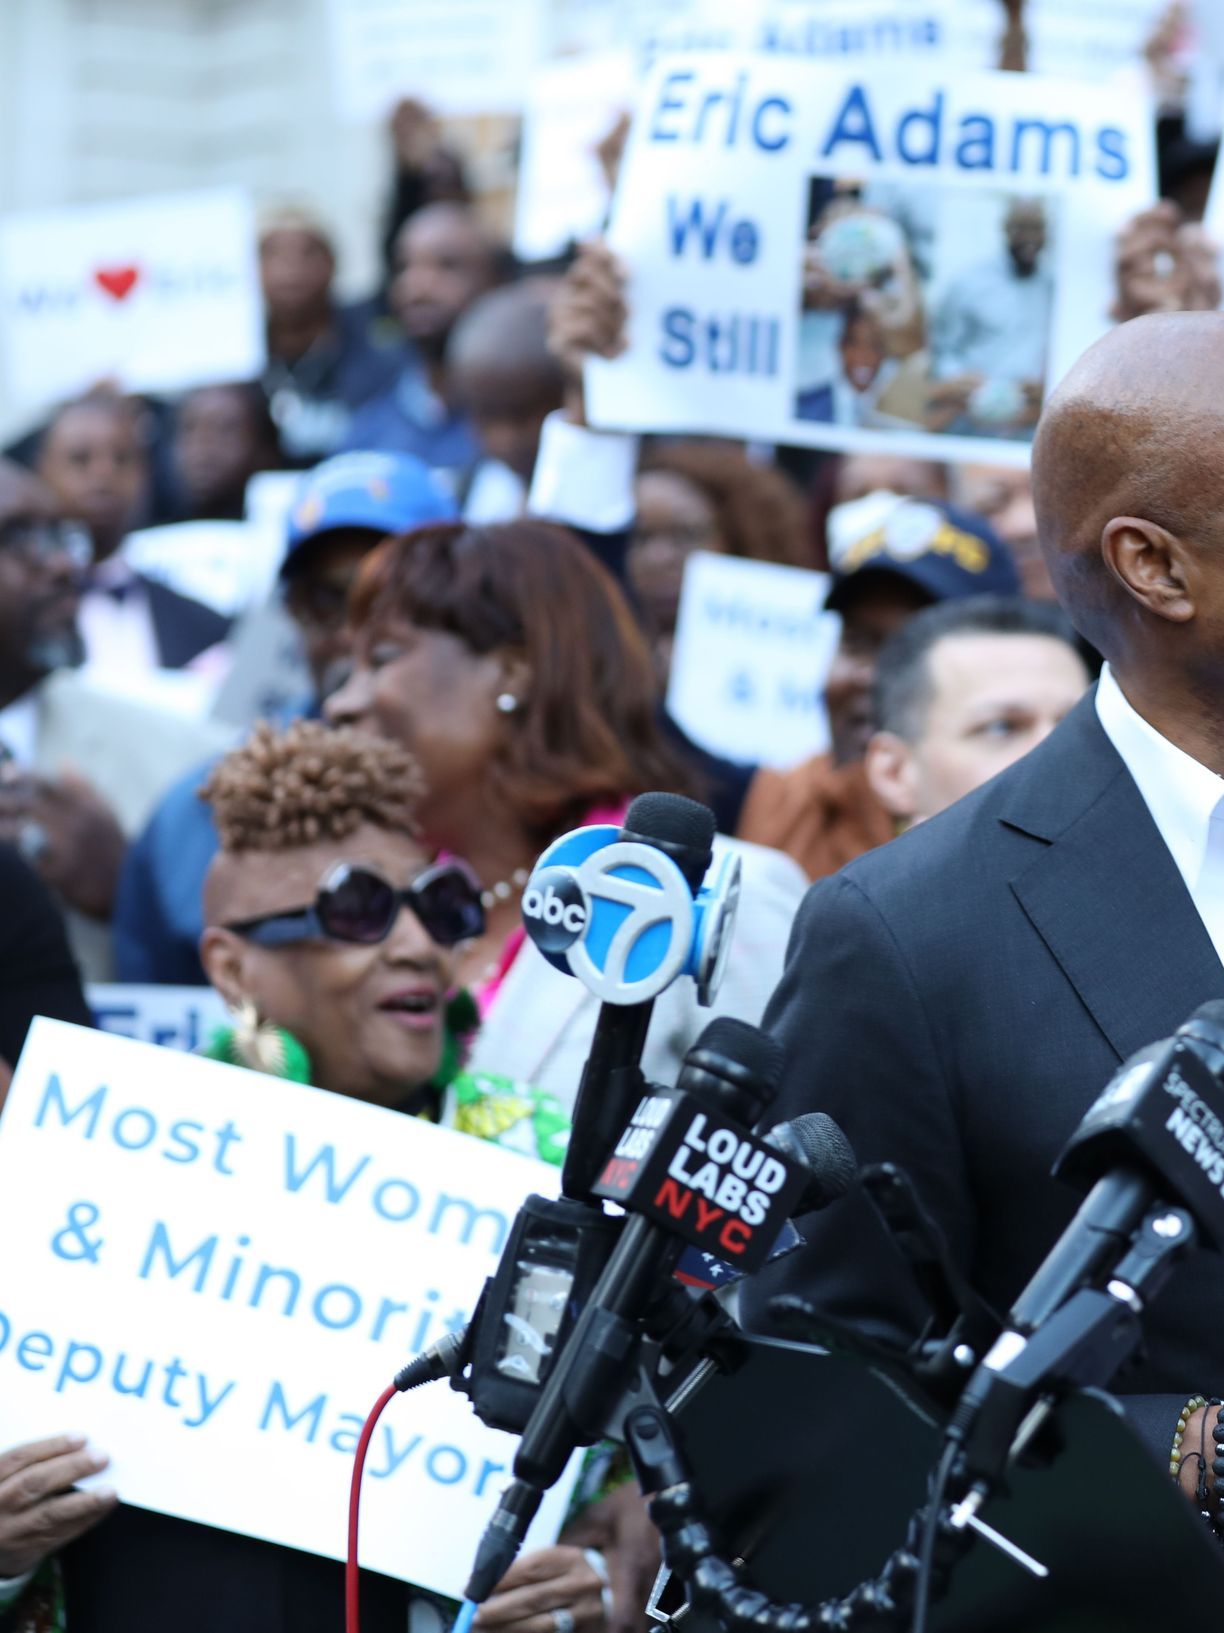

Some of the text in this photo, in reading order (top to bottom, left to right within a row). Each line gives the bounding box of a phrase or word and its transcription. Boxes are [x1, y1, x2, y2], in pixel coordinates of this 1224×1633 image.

[650, 70, 1132, 182] Eric Adams
[666, 194, 762, 268] We
[660, 306, 782, 378] Still
[522, 888, 586, 933] abc
[32, 1070, 510, 1258] Most Wom
[667, 1144, 772, 1226] LABS
[684, 1112, 788, 1196] LOUD
[653, 1177, 753, 1255] NYC
[50, 1200, 470, 1354] & Minori
[0, 1312, 236, 1428] eputy
